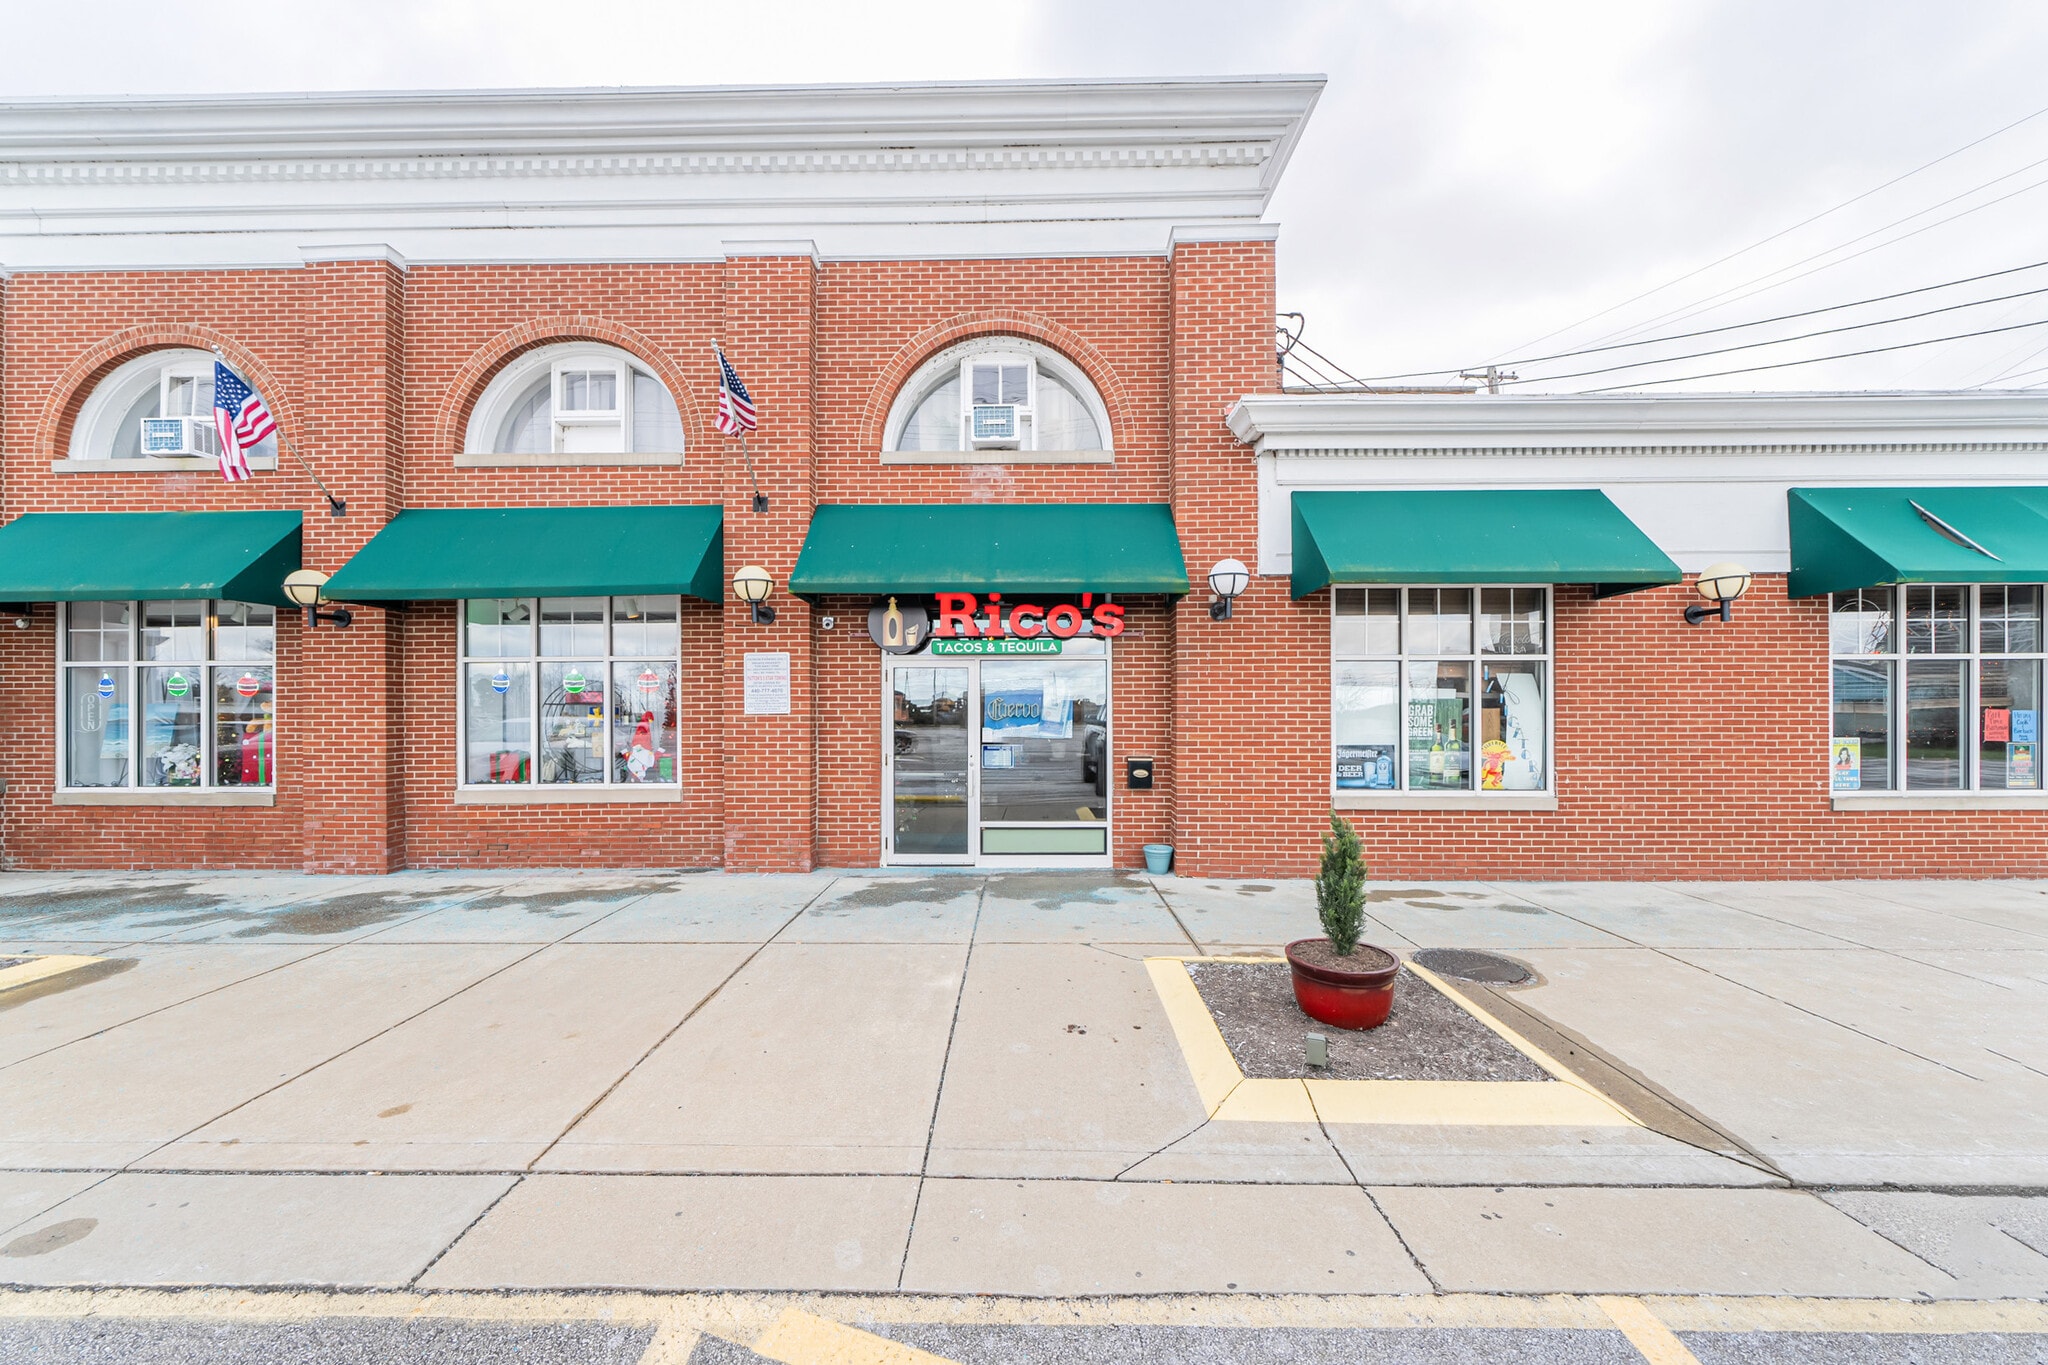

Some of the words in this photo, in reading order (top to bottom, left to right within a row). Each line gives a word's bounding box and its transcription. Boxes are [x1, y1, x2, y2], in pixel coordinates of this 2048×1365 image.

[935, 592, 1125, 637] Rico's
[937, 642, 983, 653] TACOS
[987, 642, 995, 653] &
[1000, 641, 1058, 653] TEQUILA
[87, 694, 95, 730] OPEN
[987, 696, 1040, 721] Cuervo
[1409, 704, 1434, 717] GRAB
[1408, 716, 1433, 728] SOME
[1408, 727, 1433, 737] GREEN
